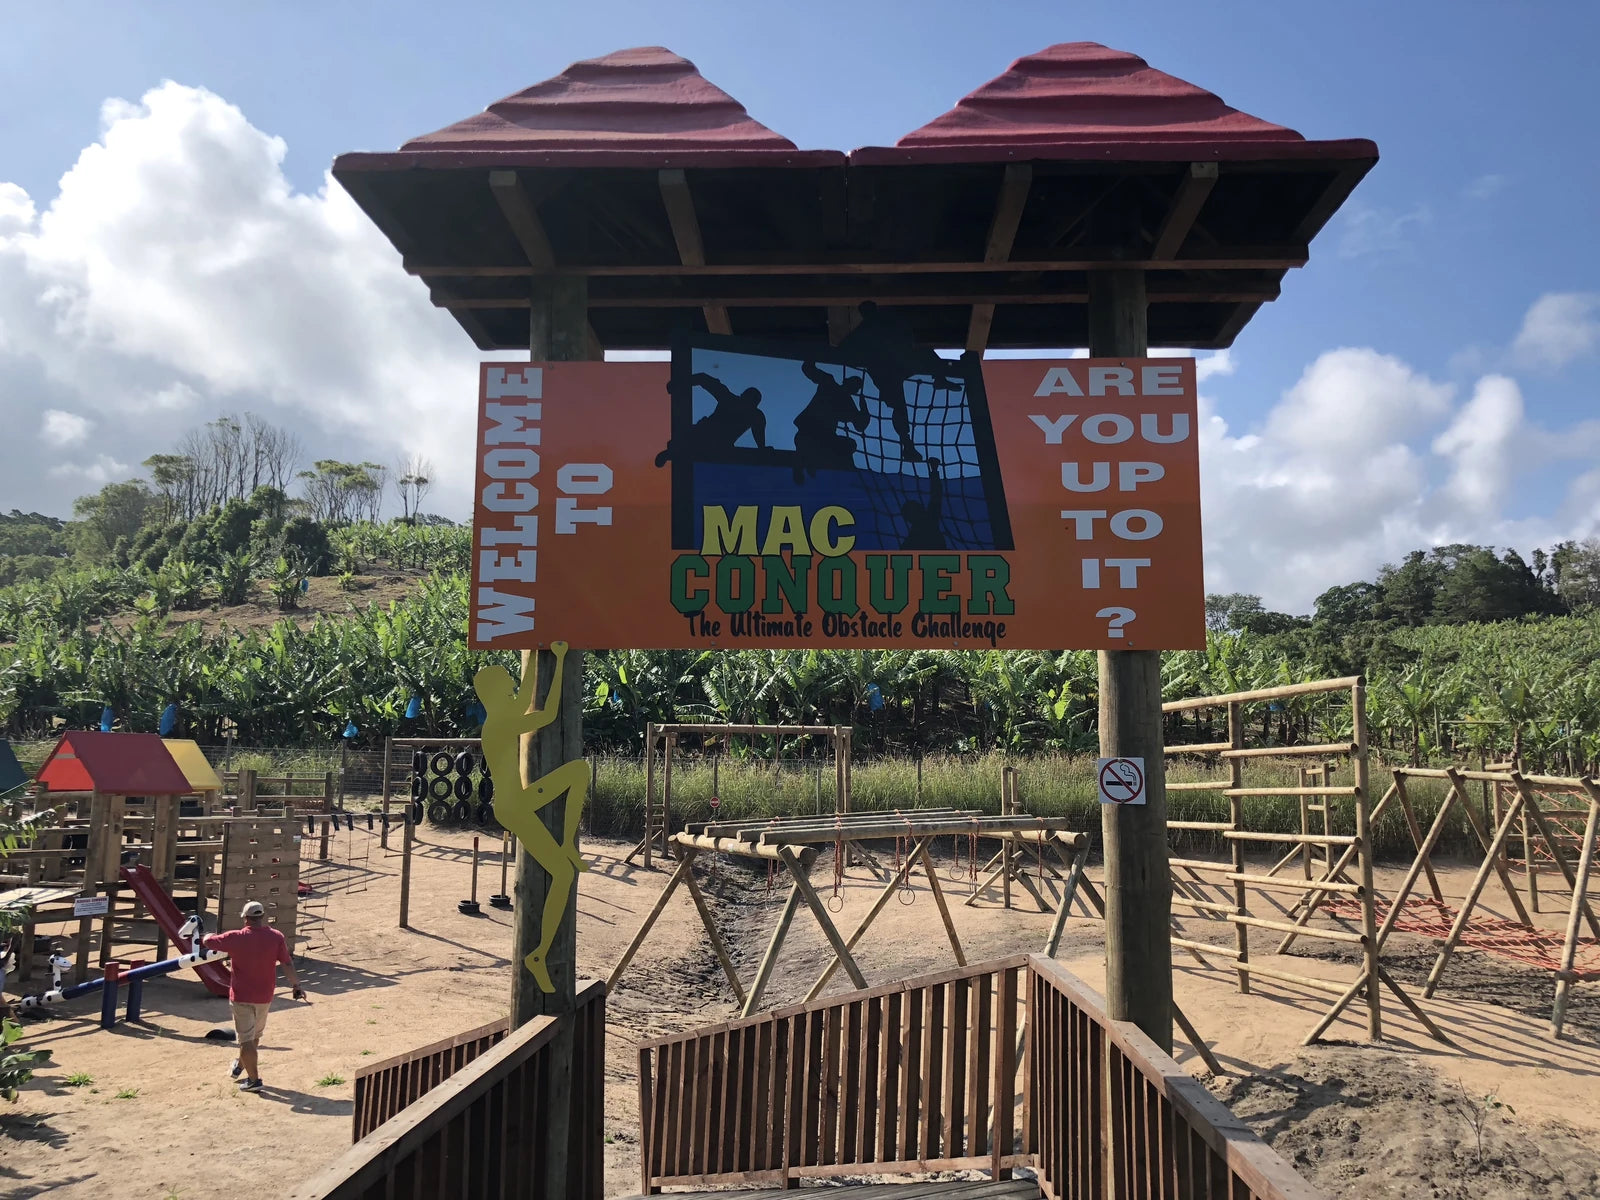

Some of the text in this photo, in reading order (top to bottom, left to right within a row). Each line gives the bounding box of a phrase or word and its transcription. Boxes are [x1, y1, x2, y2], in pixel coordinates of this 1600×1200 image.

[1033, 366, 1184, 397] ARE
[1027, 413, 1190, 444] YOU
[1061, 461, 1165, 492] UP
[476, 367, 543, 642] WELCOME
[555, 463, 613, 534] TO
[700, 505, 856, 557] MAC
[1060, 509, 1163, 540] TO
[670, 554, 1015, 618] CONQUER
[1081, 558, 1151, 589] IT
[683, 610, 1007, 647] The Ultimate Obstacle Challenge
[1095, 606, 1137, 638] ?
